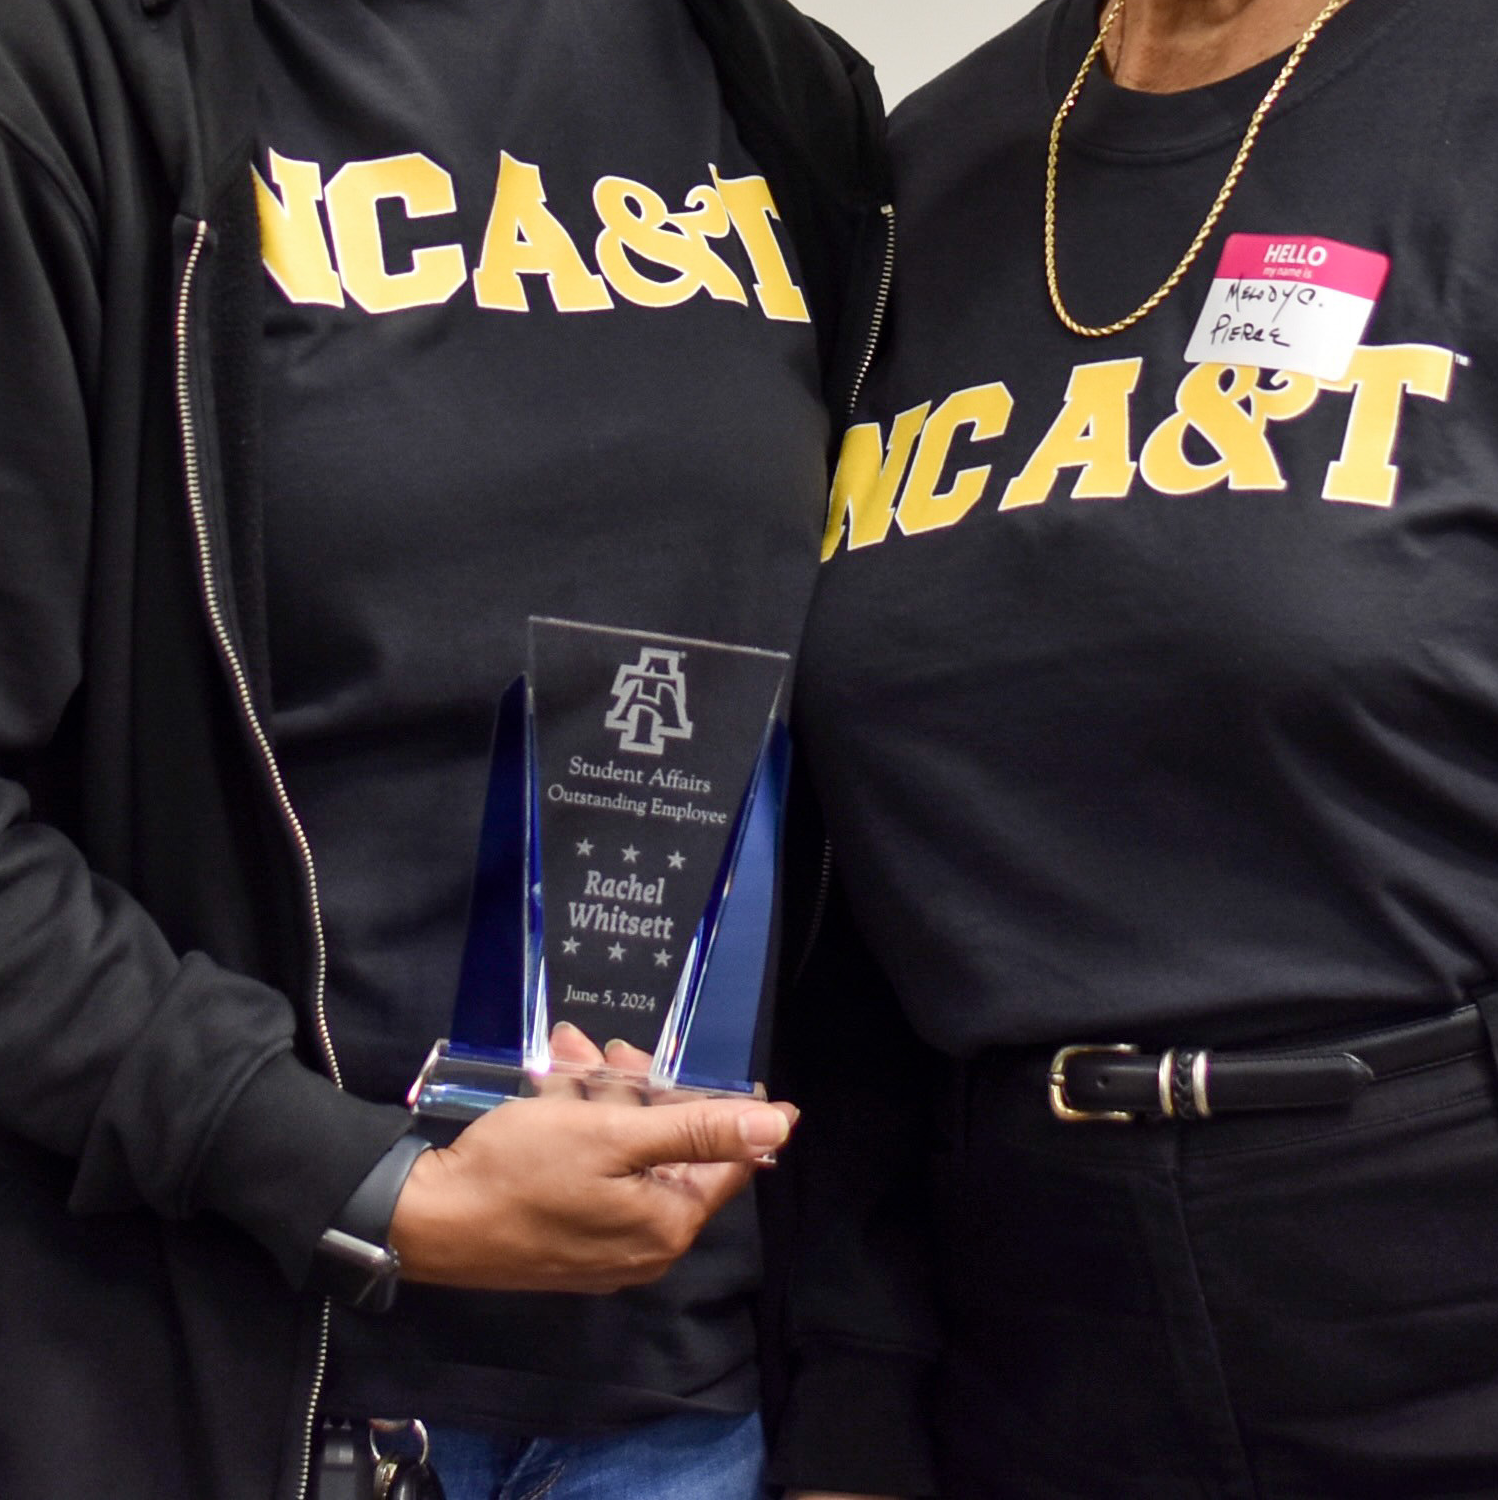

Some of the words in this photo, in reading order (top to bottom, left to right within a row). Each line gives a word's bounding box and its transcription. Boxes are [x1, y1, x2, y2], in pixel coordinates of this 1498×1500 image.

[251, 148, 467, 314] NC
[473, 150, 812, 323] A&T
[1263, 244, 1327, 267] HELLO
[1277, 267, 1302, 278] name
[820, 381, 1014, 564] NC
[998, 343, 1454, 510] A&T
[568, 756, 644, 783] Student
[648, 767, 712, 794] Affairs
[548, 784, 647, 815] Outstanding
[650, 798, 728, 826] Employee
[584, 870, 665, 904] Rachel
[568, 902, 674, 940] Whitsett
[564, 984, 599, 1004] June
[601, 990, 616, 1009] 5,
[620, 992, 656, 1012] 2024
